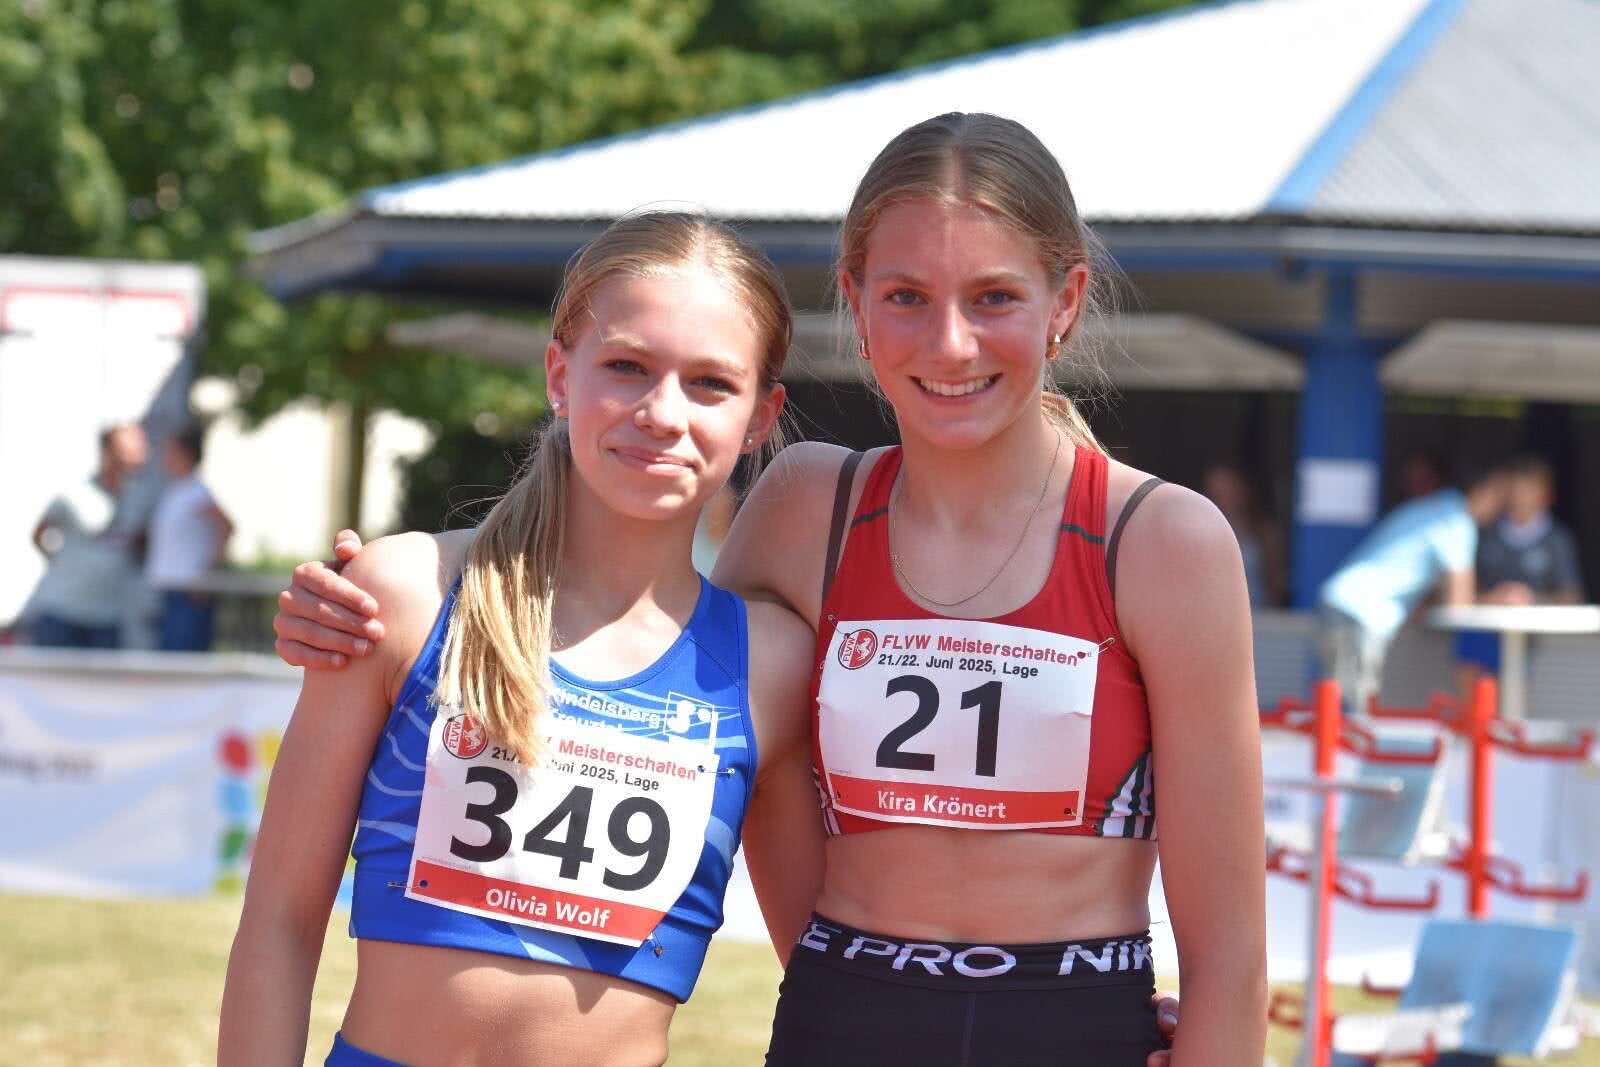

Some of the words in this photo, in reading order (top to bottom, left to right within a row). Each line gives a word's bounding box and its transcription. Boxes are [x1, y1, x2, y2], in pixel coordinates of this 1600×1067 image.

[843, 636, 855, 662] FLVW
[882, 634, 931, 650] FLVW
[937, 635, 1077, 667] Meisterschaften
[878, 653, 920, 666] 21./22.
[926, 655, 954, 669] Juni
[959, 658, 996, 675] 2025,
[1002, 662, 1039, 679] Lage
[448, 720, 461, 749] FLVW
[876, 674, 1002, 777] 21
[558, 738, 697, 782] Meisterschaften
[580, 764, 618, 784] 2025,
[624, 772, 660, 791] Lage
[877, 790, 916, 811] Kira
[923, 794, 1007, 819] Krönert
[450, 766, 671, 891] 349
[485, 888, 548, 917] Olivia
[555, 901, 611, 928] Wolf
[843, 936, 1017, 978] PRO
